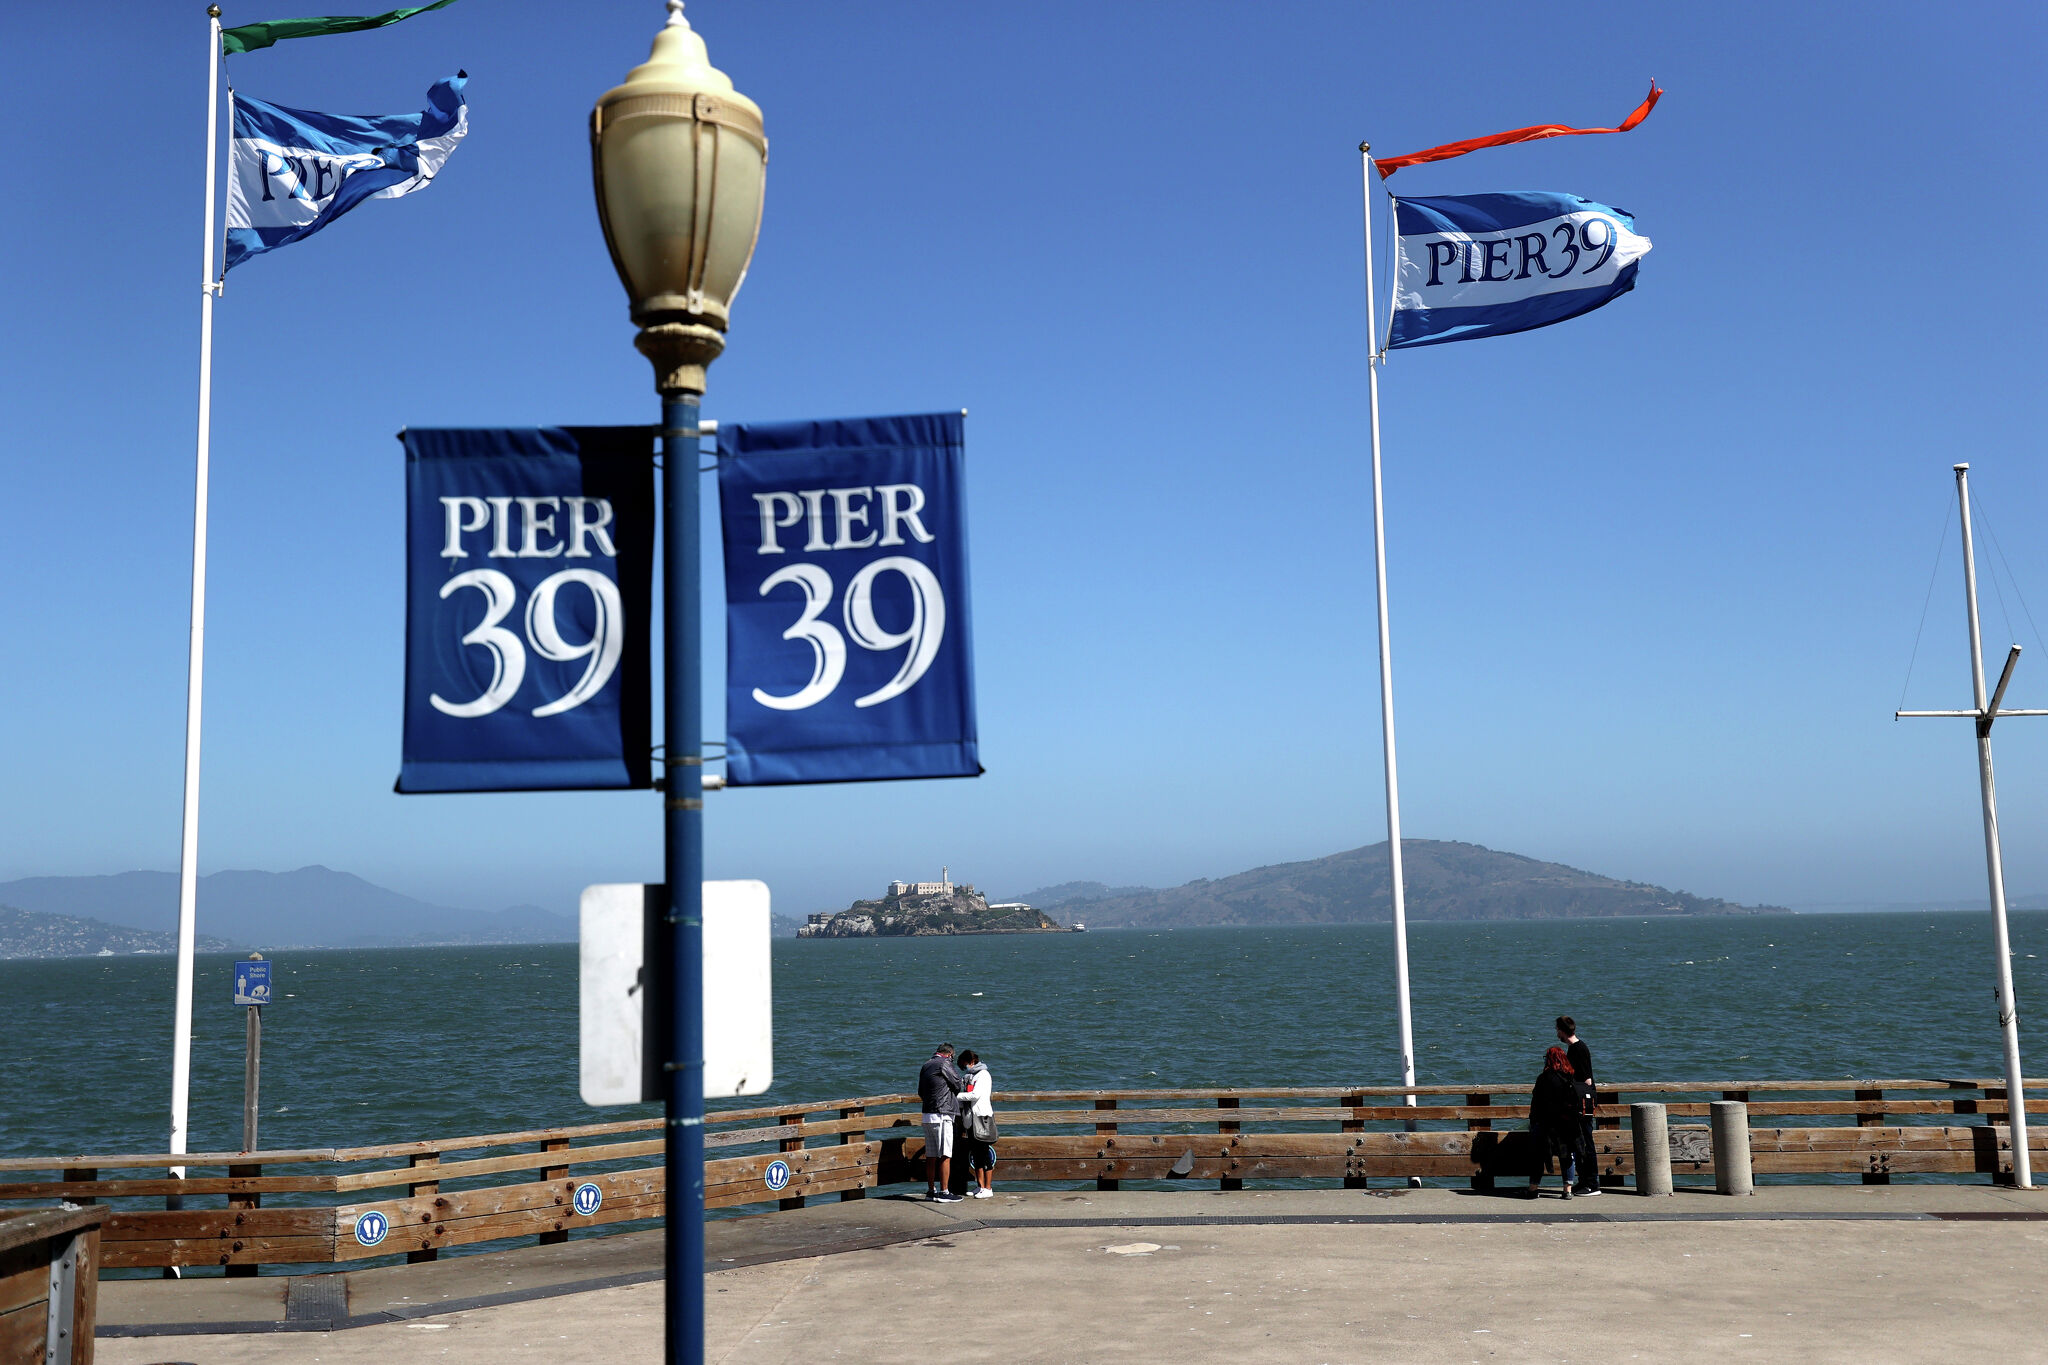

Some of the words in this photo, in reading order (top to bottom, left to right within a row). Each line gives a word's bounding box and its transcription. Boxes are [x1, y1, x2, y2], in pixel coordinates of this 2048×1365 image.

[1425, 232, 1551, 286] PIER
[1547, 217, 1618, 279] 39
[439, 496, 620, 559] PIER
[752, 483, 935, 555] PIER
[429, 568, 623, 719] 39
[752, 556, 946, 711] 39
